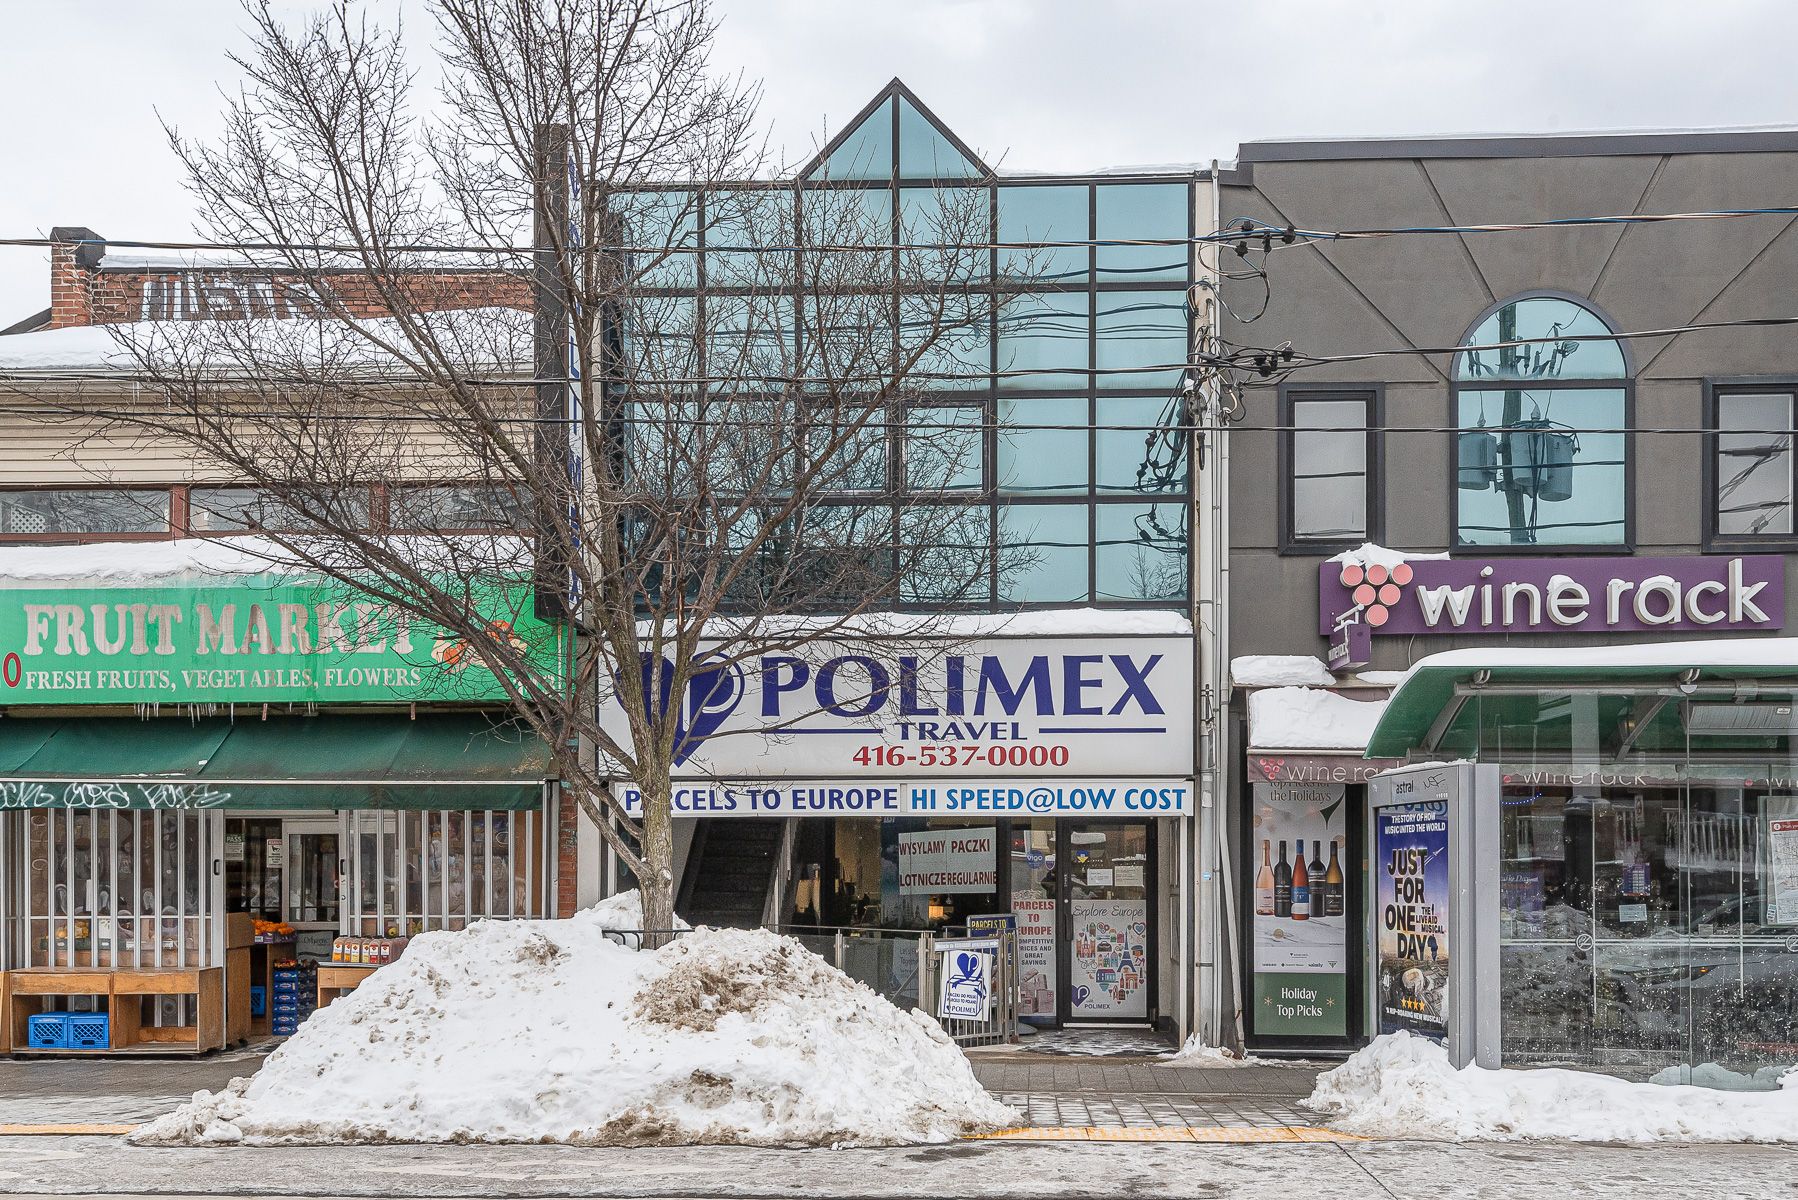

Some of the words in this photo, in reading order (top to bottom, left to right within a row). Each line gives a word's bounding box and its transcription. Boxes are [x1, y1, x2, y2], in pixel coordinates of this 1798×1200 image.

[1415, 565, 1590, 627] wine
[1606, 557, 1771, 625] rack
[23, 603, 183, 656] FRUIT
[195, 602, 414, 655] MARKET
[25, 670, 92, 690] FRESH
[96, 669, 177, 693] FRUITS,
[180, 668, 319, 690] VEGETABLES,
[323, 666, 422, 687] FLOWERS
[760, 653, 1166, 718] POLIMEX
[893, 721, 1028, 741] TRAVEL
[851, 744, 1070, 767] 416-537-0000
[1286, 760, 1347, 782] wine
[1270, 790, 1287, 801] the
[1288, 789, 1332, 804] Holidays
[1396, 779, 1414, 794] astral
[625, 788, 738, 812] PCELS
[746, 788, 781, 811] TO
[791, 787, 898, 811] EUROPE
[911, 788, 937, 810] HI
[1124, 787, 1187, 811] COST
[1425, 821, 1446, 832] WORLD
[899, 840, 946, 856] WYSYLAMY
[951, 838, 991, 854] PACZKI
[1386, 847, 1428, 876] JUST
[899, 872, 947, 887] LOTNICZE
[947, 870, 997, 885] REGULARNIE
[1395, 877, 1426, 904] FOR
[1012, 900, 1055, 911] PARCELS
[1072, 903, 1108, 918] Explore
[1111, 904, 1144, 920] Europe
[1027, 913, 1041, 923] TO
[1384, 903, 1416, 932] ONE
[1397, 932, 1428, 961] DAY
[1281, 987, 1318, 1002] Holiday
[1276, 1004, 1293, 1019] Top
[1296, 1003, 1323, 1017] Picks
